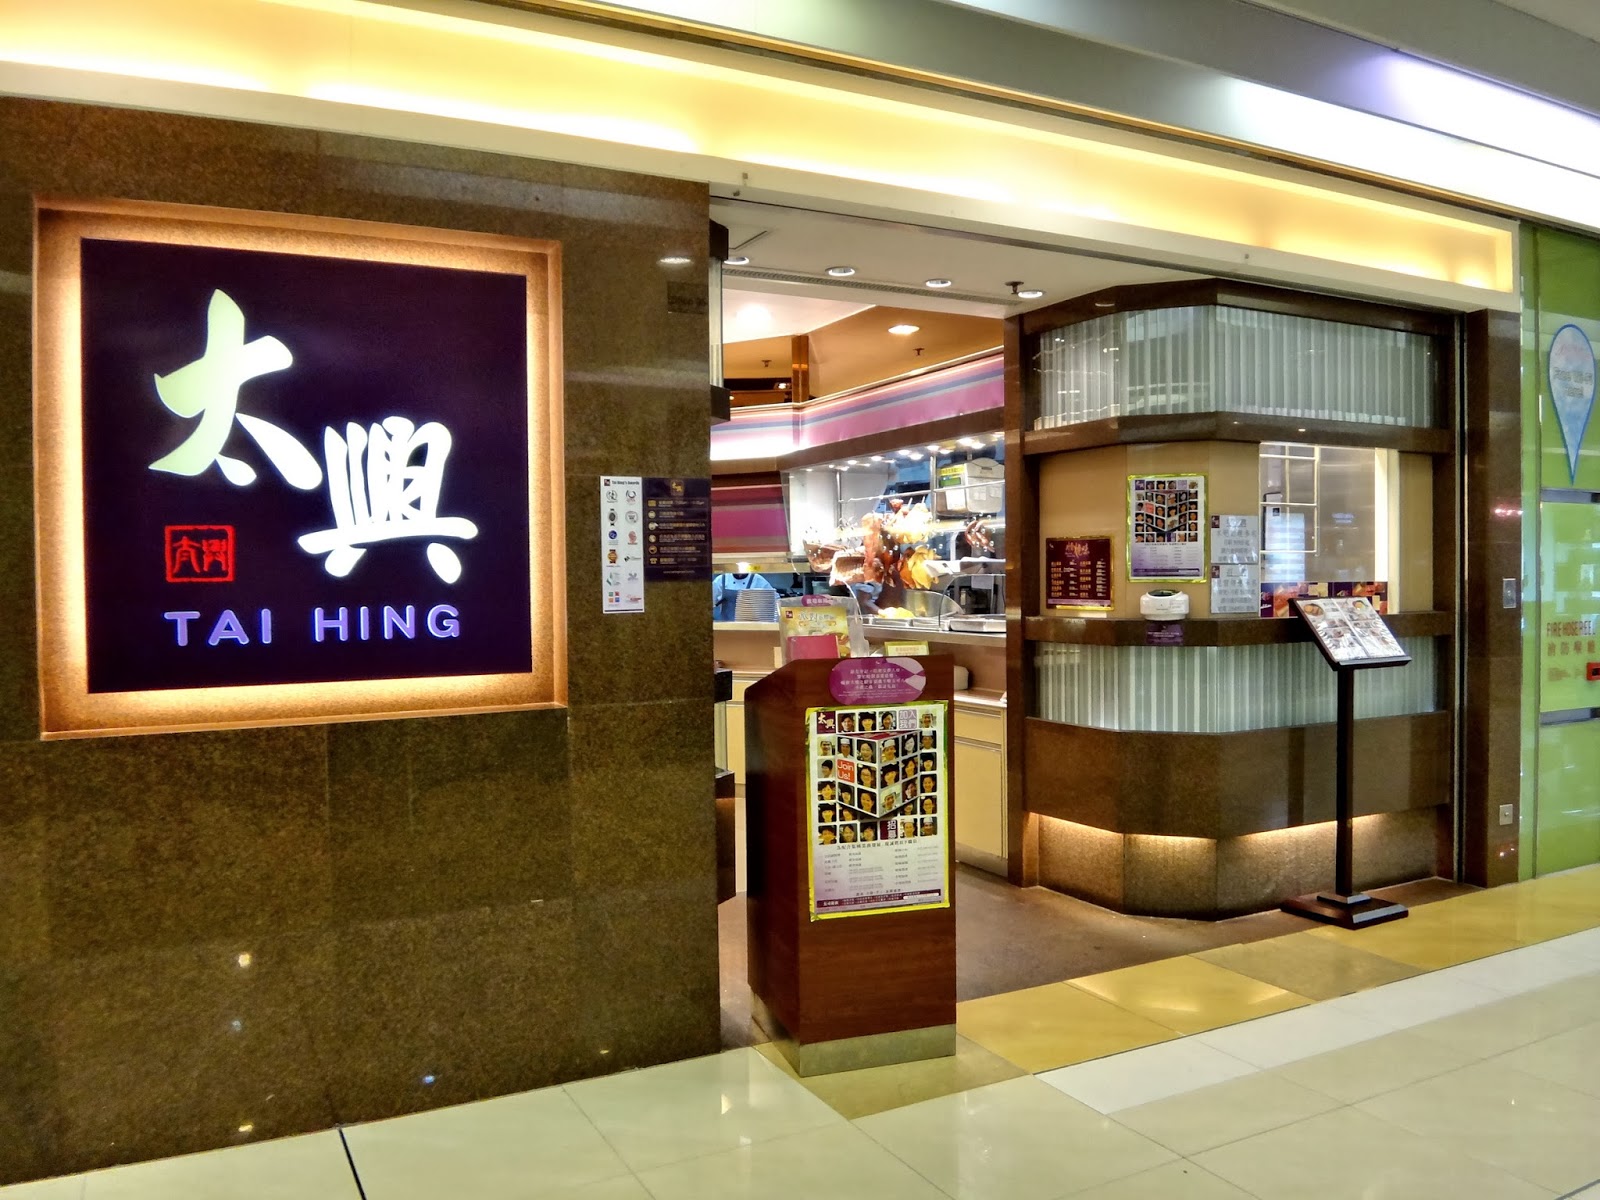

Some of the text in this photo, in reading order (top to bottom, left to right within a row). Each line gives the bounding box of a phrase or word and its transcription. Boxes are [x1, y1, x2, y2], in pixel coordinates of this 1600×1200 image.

[149, 288, 480, 585] 太興
[163, 603, 462, 647] TAI HING
[1546, 622, 1562, 637] FIRE
[899, 709, 917, 719] 加入
[837, 760, 854, 772] Join
[837, 769, 851, 781] Us!
